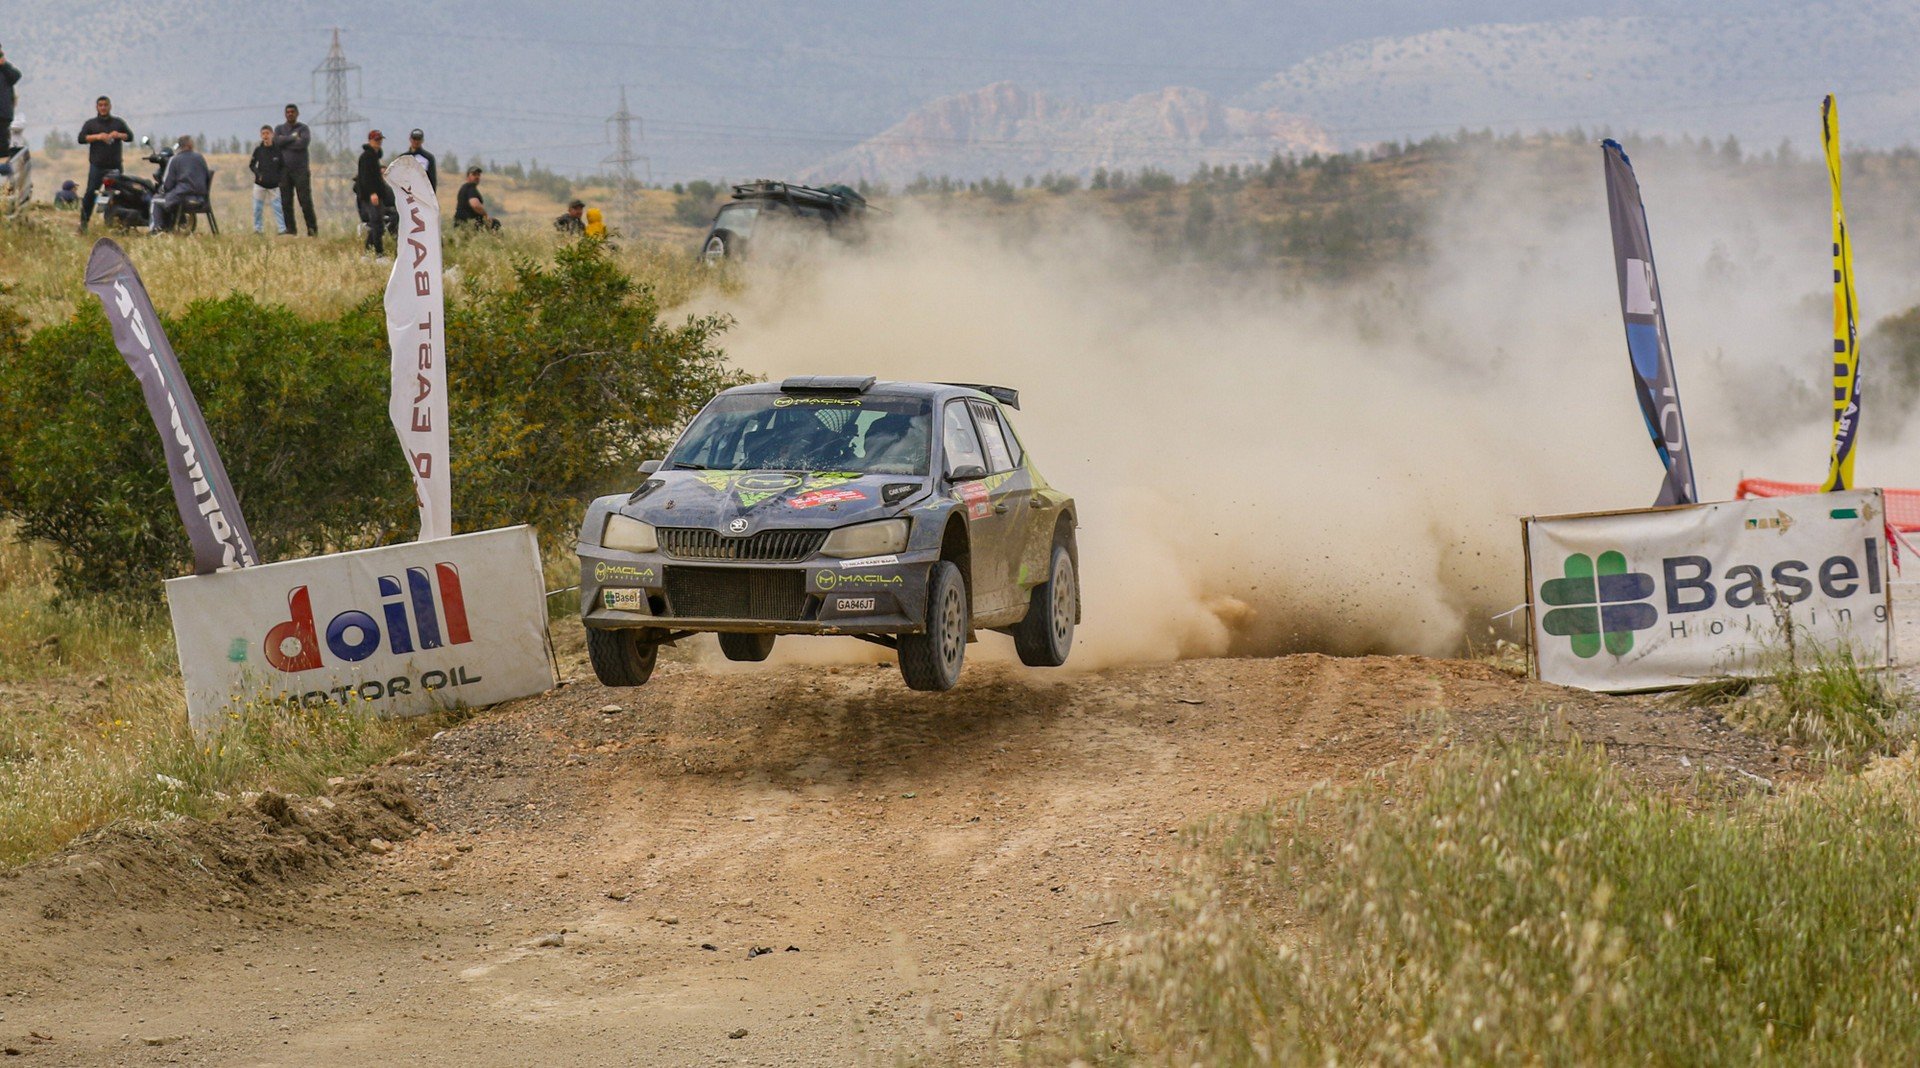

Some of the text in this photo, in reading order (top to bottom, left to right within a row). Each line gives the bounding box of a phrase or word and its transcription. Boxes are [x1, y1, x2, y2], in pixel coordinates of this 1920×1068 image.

[795, 398, 862, 406] MACILA
[605, 565, 654, 576] MACILA
[1662, 537, 1882, 615] Basel
[838, 574, 903, 583] MACILA
[614, 592, 638, 603] Basel
[837, 599, 874, 610] GA846JT
[264, 561, 474, 673] doill
[420, 666, 482, 691] OIL
